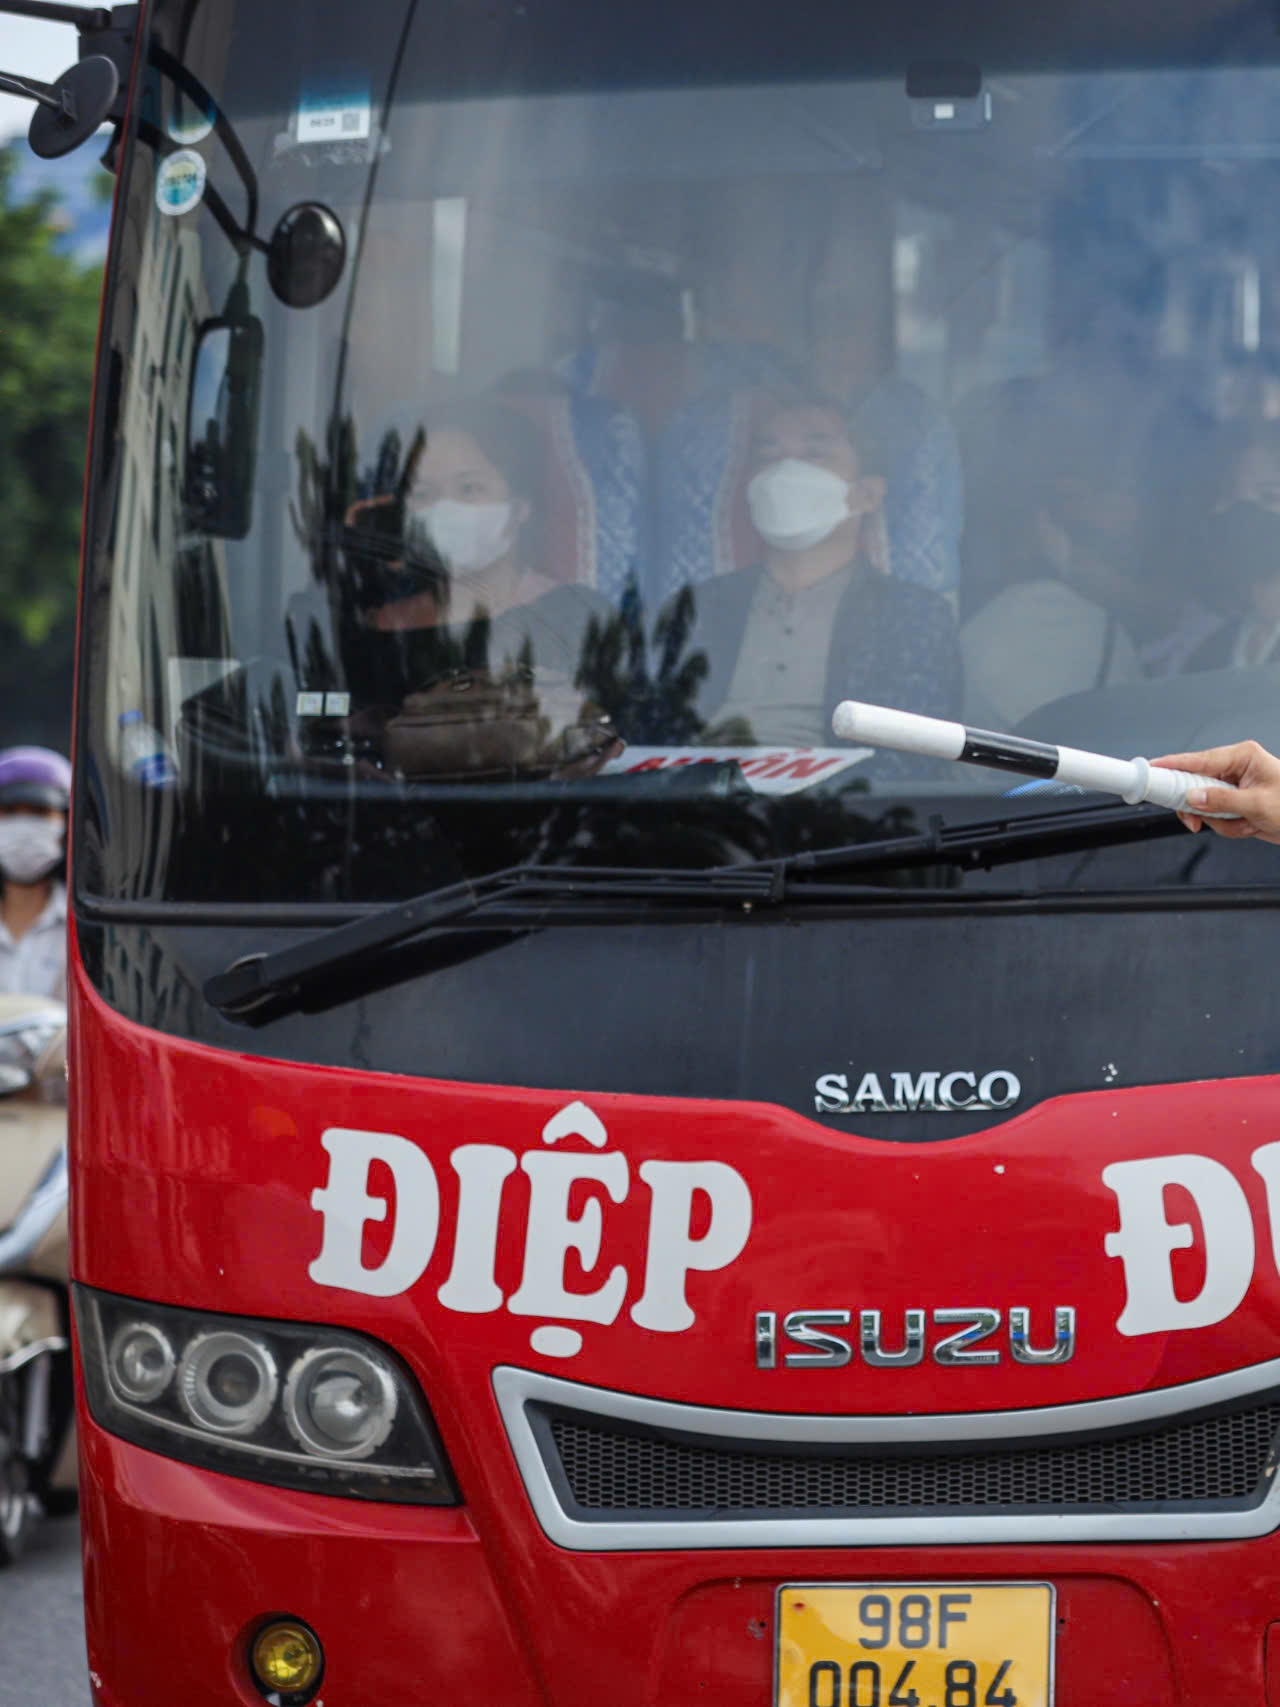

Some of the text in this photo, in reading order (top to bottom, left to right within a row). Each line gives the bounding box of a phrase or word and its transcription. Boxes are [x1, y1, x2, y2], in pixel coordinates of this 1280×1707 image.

[814, 1070, 1021, 1113] SAMCO
[308, 1101, 753, 1357] ĐIỆP
[755, 1307, 1076, 1369] ISUZU
[858, 1593, 972, 1650] 98F
[809, 1660, 1018, 1707] 004.84
